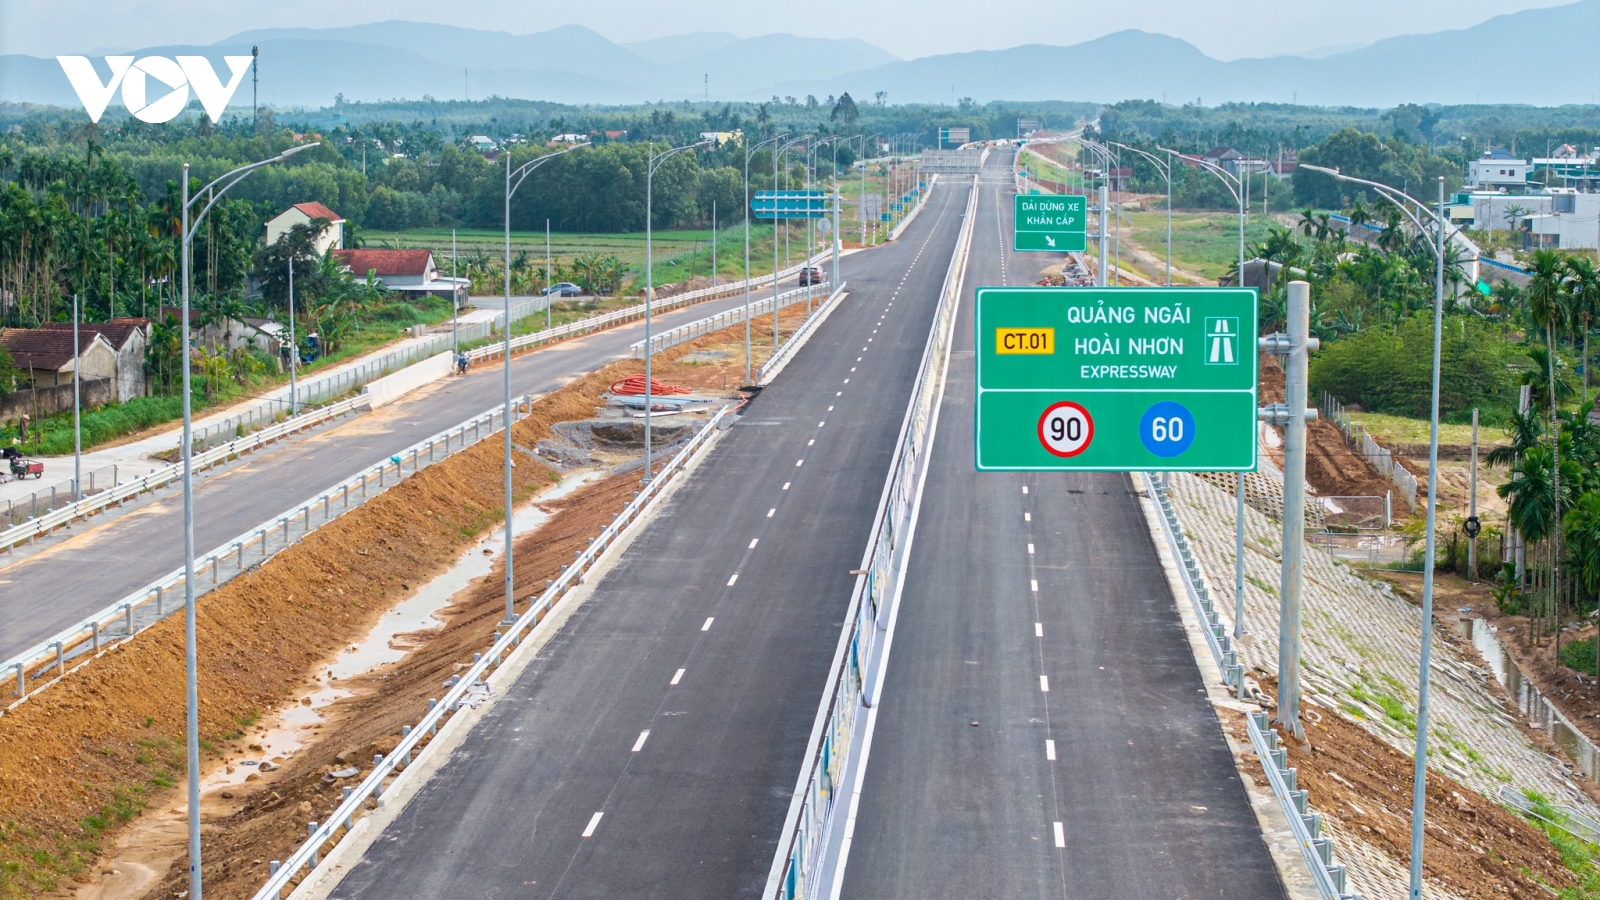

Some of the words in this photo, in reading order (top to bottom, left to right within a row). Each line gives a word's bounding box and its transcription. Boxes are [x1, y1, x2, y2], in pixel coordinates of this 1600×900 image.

[1022, 199, 1037, 211] DẢI
[1039, 200, 1065, 211] DỪNG
[1067, 203, 1080, 211] XE
[1055, 213, 1075, 225] CẤP
[1067, 300, 1135, 324] QUẢNG
[1144, 303, 1191, 324] NGÃI
[1003, 333, 1047, 350] CT.01
[1075, 332, 1120, 355] HOÀI
[1128, 336, 1184, 355] NHƠN
[1080, 365, 1178, 379] EXPRESSWAY
[1050, 416, 1082, 442] 90
[1152, 416, 1184, 442] 60
